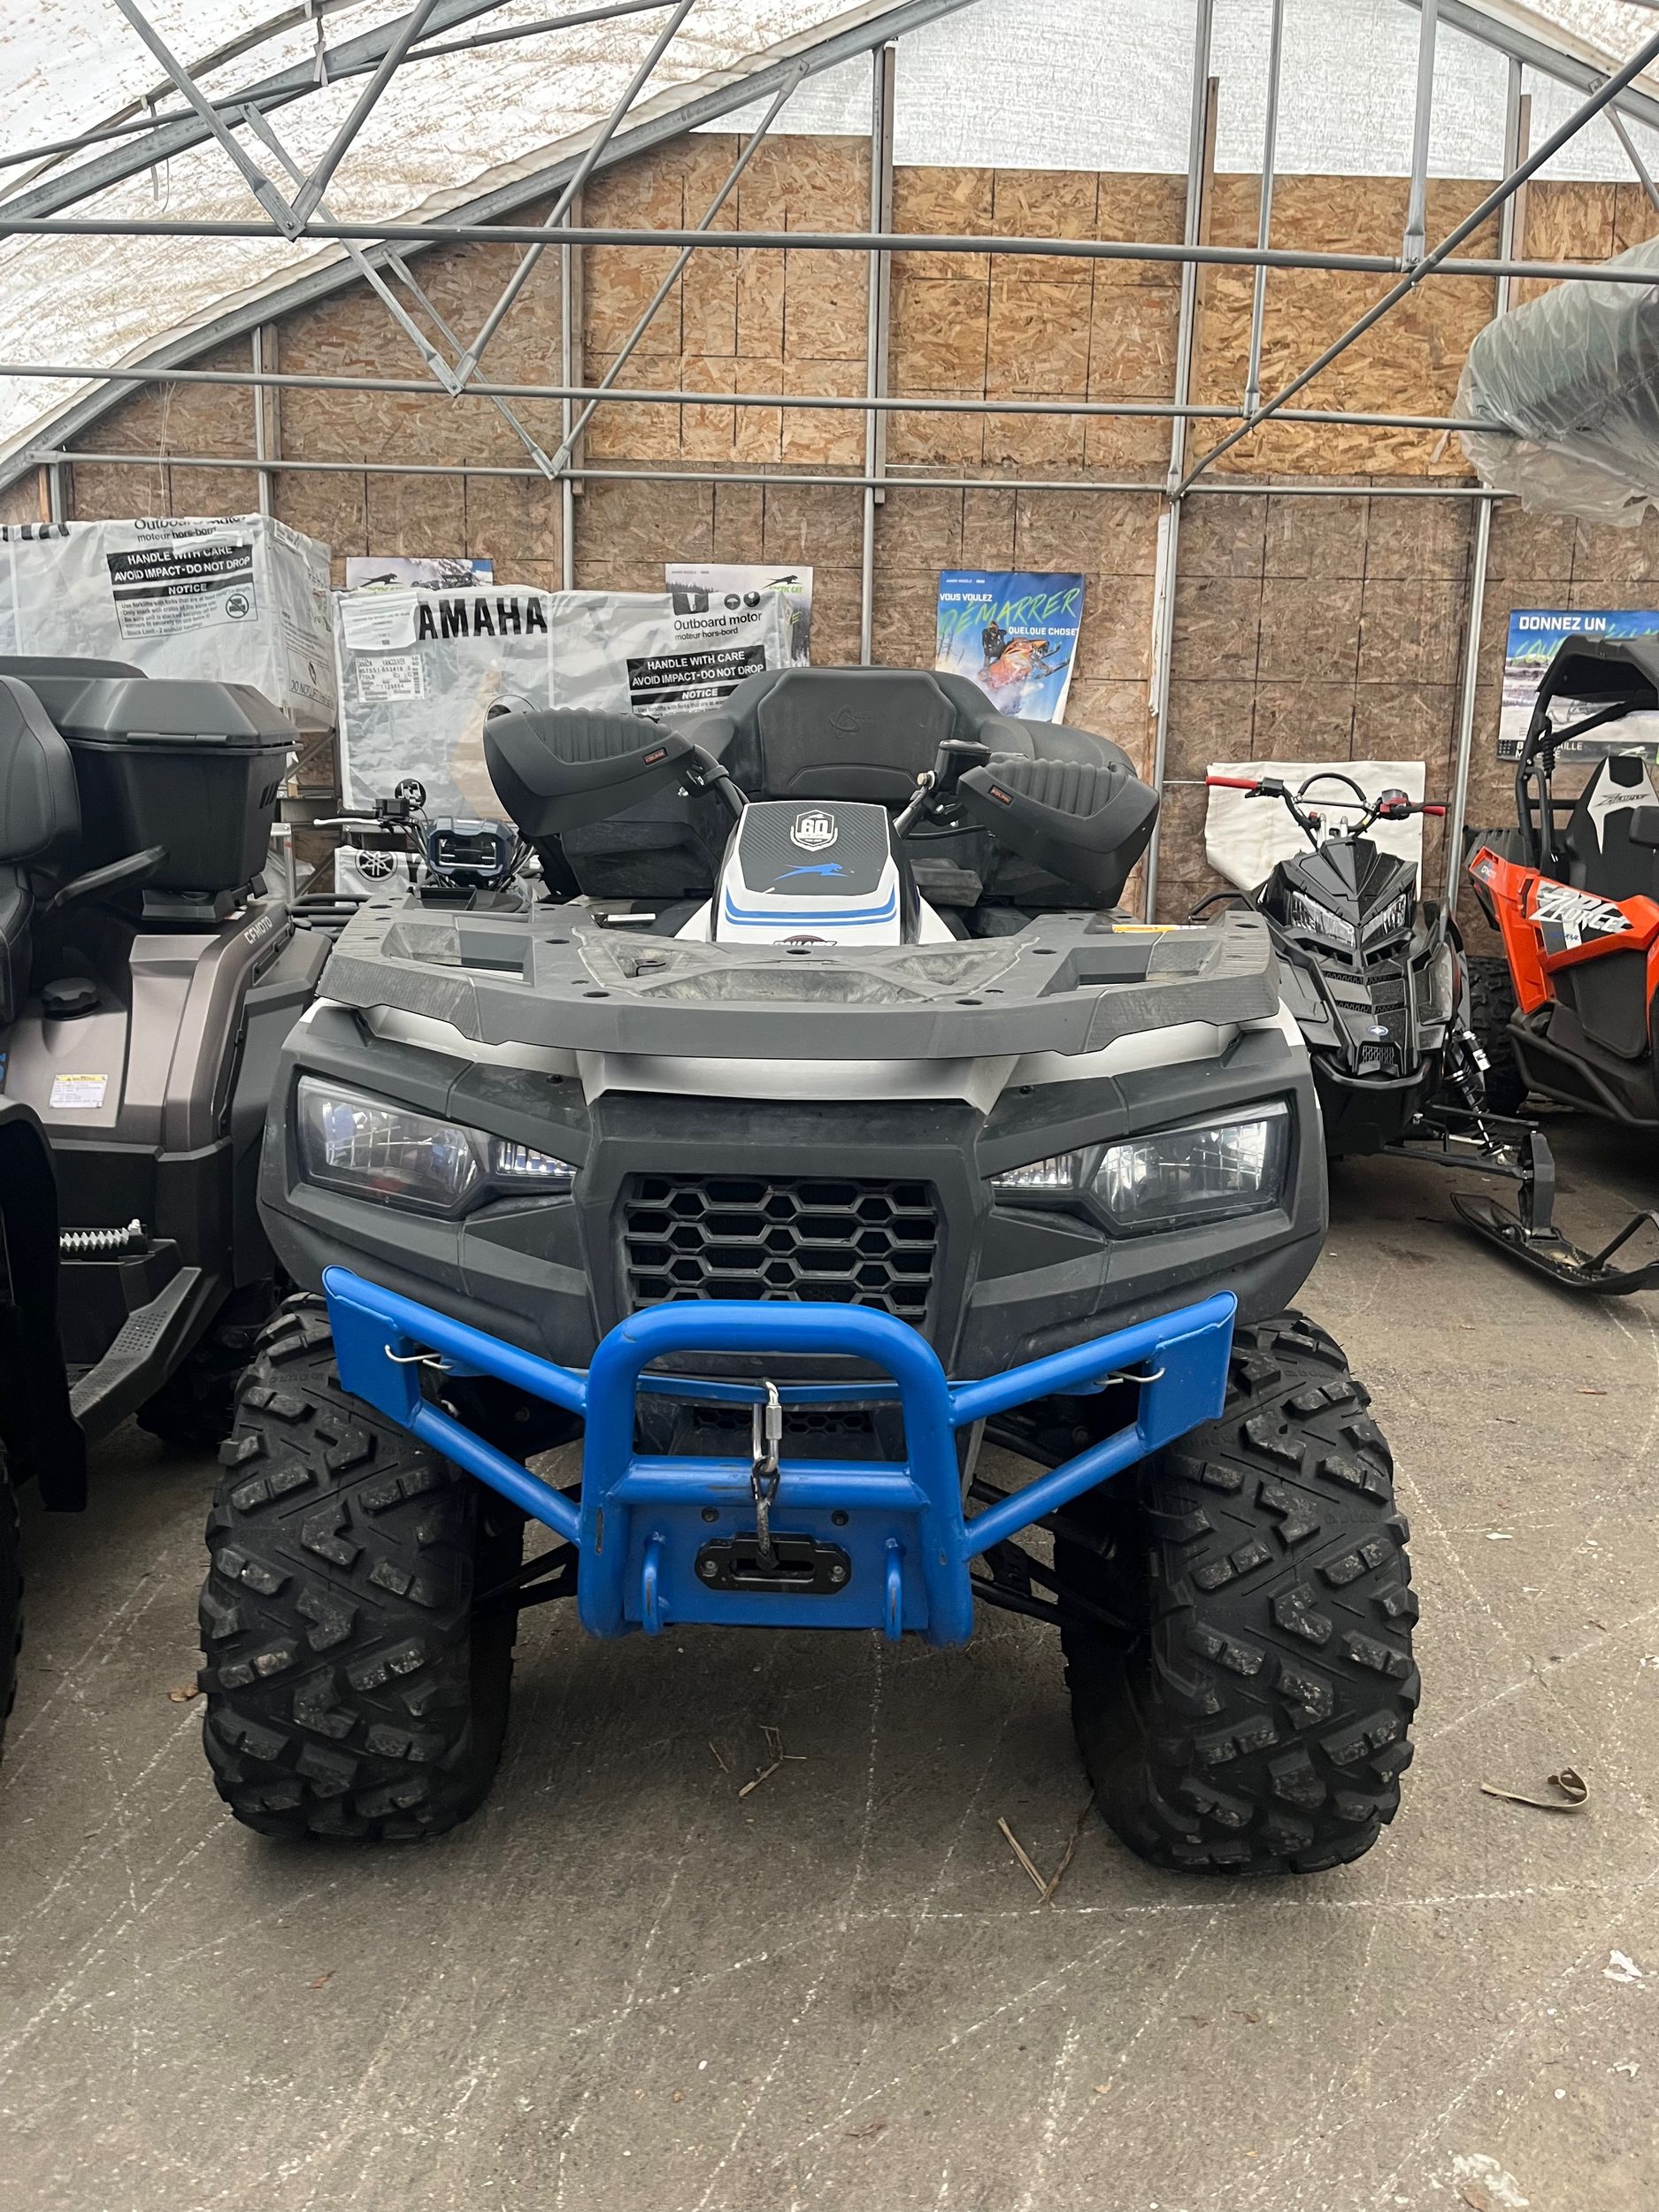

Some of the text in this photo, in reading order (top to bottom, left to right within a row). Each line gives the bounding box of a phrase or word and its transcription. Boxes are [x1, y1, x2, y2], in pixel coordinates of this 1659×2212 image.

[137, 533, 170, 542] moteur
[127, 546, 233, 565] HANDLE WITH CARE
[114, 569, 143, 581] AVOID
[204, 562, 224, 572] NOT
[227, 556, 250, 570] DROP
[168, 583, 207, 595] NOTICE
[962, 593, 992, 602] VOULEZ
[419, 597, 548, 640] AMAHA
[939, 588, 1080, 637] DÉMARRER
[674, 612, 762, 631] Outboard motor
[1519, 616, 1581, 630] DONNEZ
[1585, 617, 1607, 631] UN
[675, 627, 739, 641] moteur hors-bord
[1009, 626, 1046, 635] QUELQUE
[647, 650, 745, 671] HANDLE WITH CARE
[632, 674, 661, 687] AVOID
[717, 666, 736, 677] NOT
[738, 664, 764, 675] DROP
[681, 687, 718, 700] NOTICE
[802, 819, 828, 833] 60
[244, 916, 273, 944] CFMOTO
